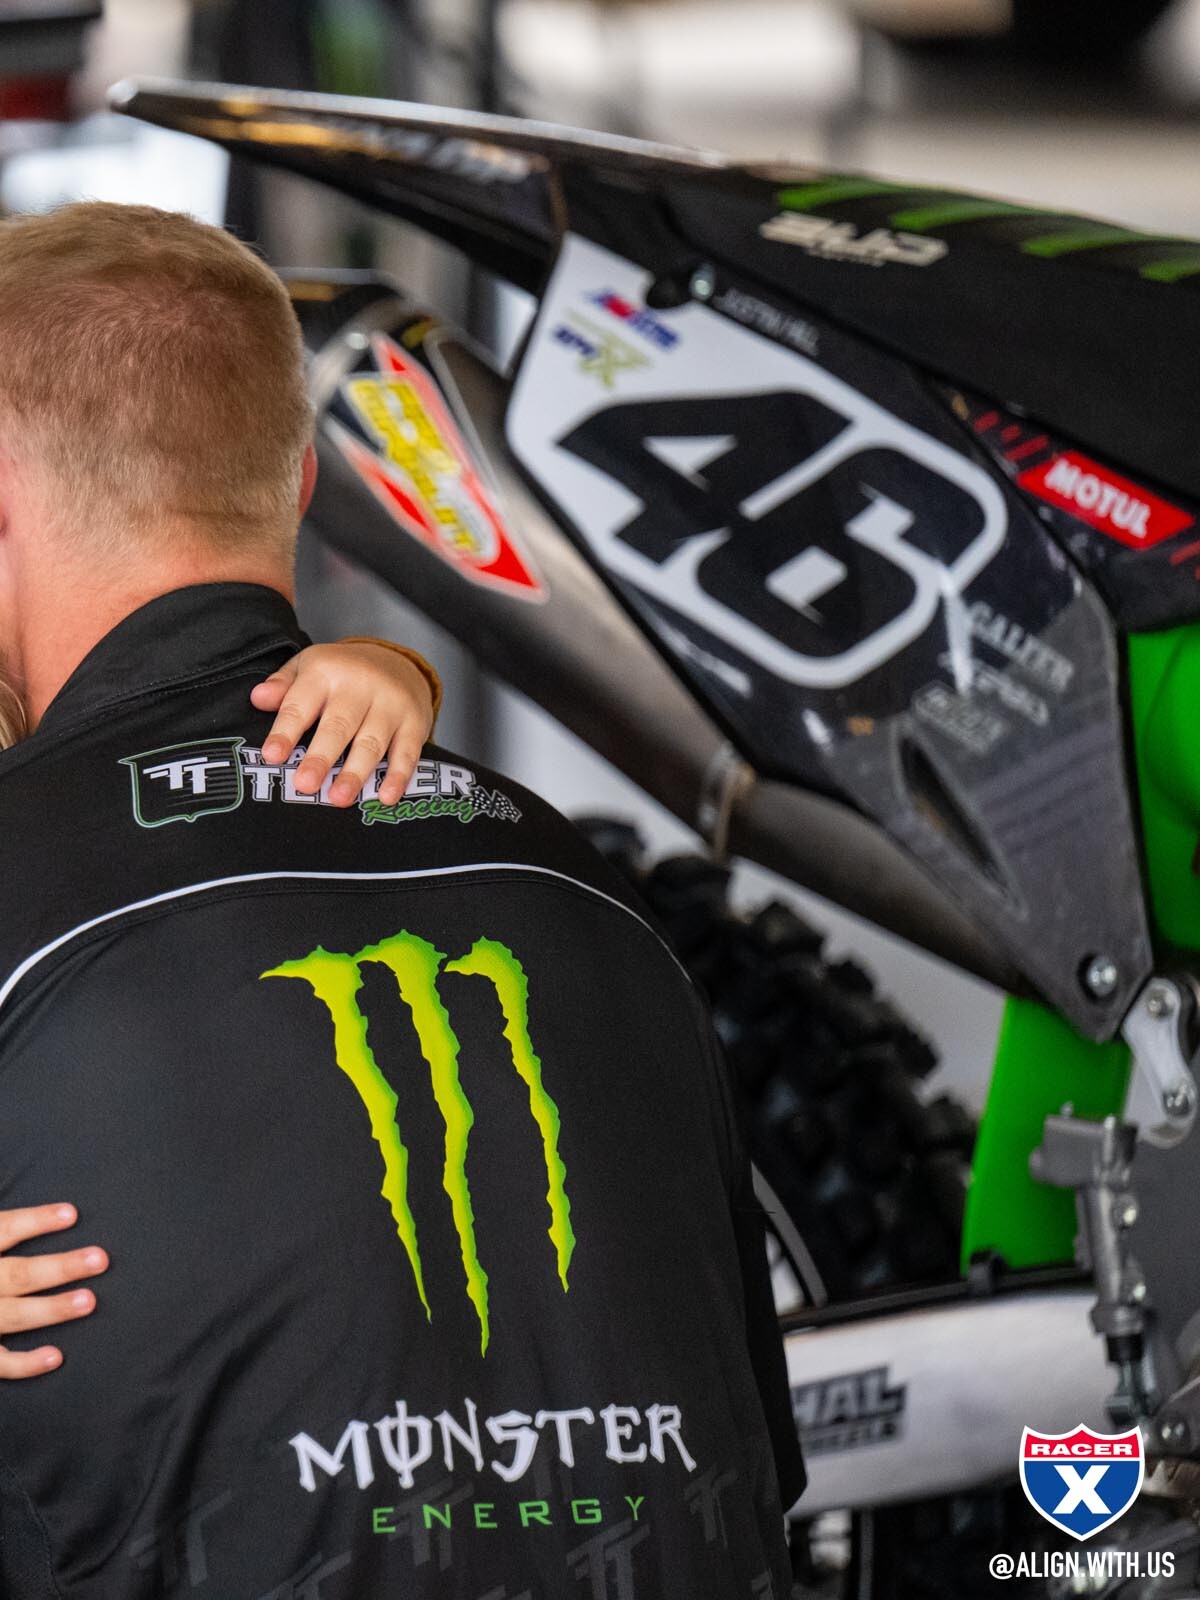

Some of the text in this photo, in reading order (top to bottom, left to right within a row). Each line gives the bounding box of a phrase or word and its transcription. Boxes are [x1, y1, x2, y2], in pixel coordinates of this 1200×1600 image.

[554, 391, 990, 660] 46
[1044, 457, 1151, 538] MOTUL
[360, 796, 477, 822] Racing
[289, 1397, 697, 1492] MONSTER
[372, 1495, 646, 1534] ENERGY
